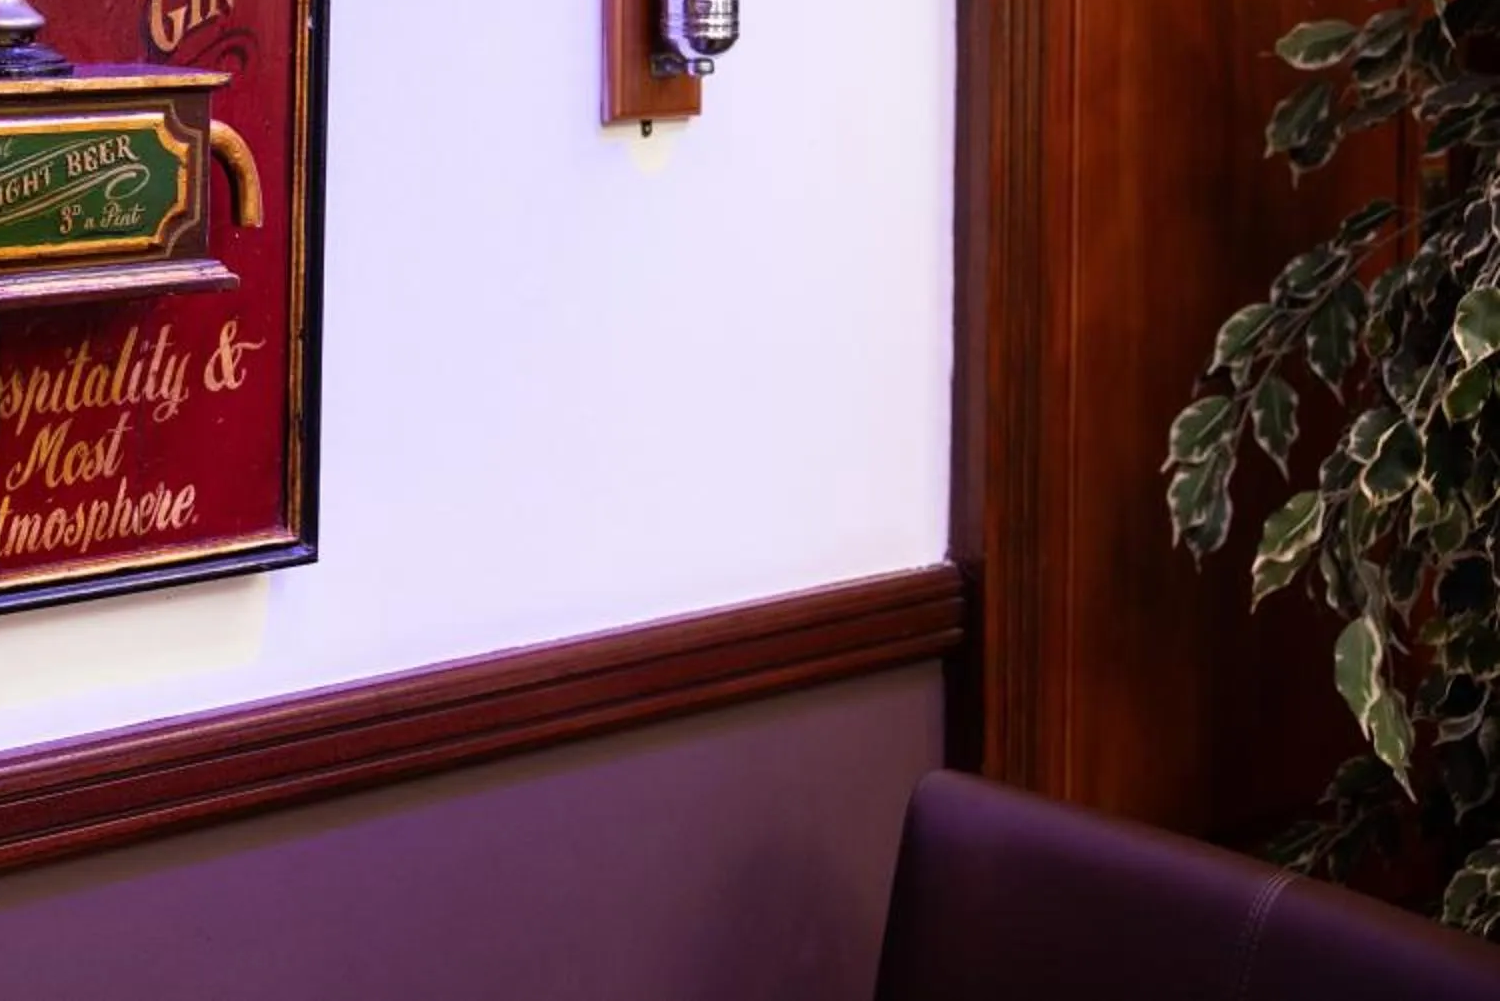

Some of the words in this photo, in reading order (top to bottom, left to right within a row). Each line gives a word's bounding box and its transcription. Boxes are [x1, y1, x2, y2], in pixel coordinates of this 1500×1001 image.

[65, 134, 141, 178] BEER
[99, 200, 147, 229] Pint
[203, 319, 267, 392] &
[5, 410, 133, 492] Most
